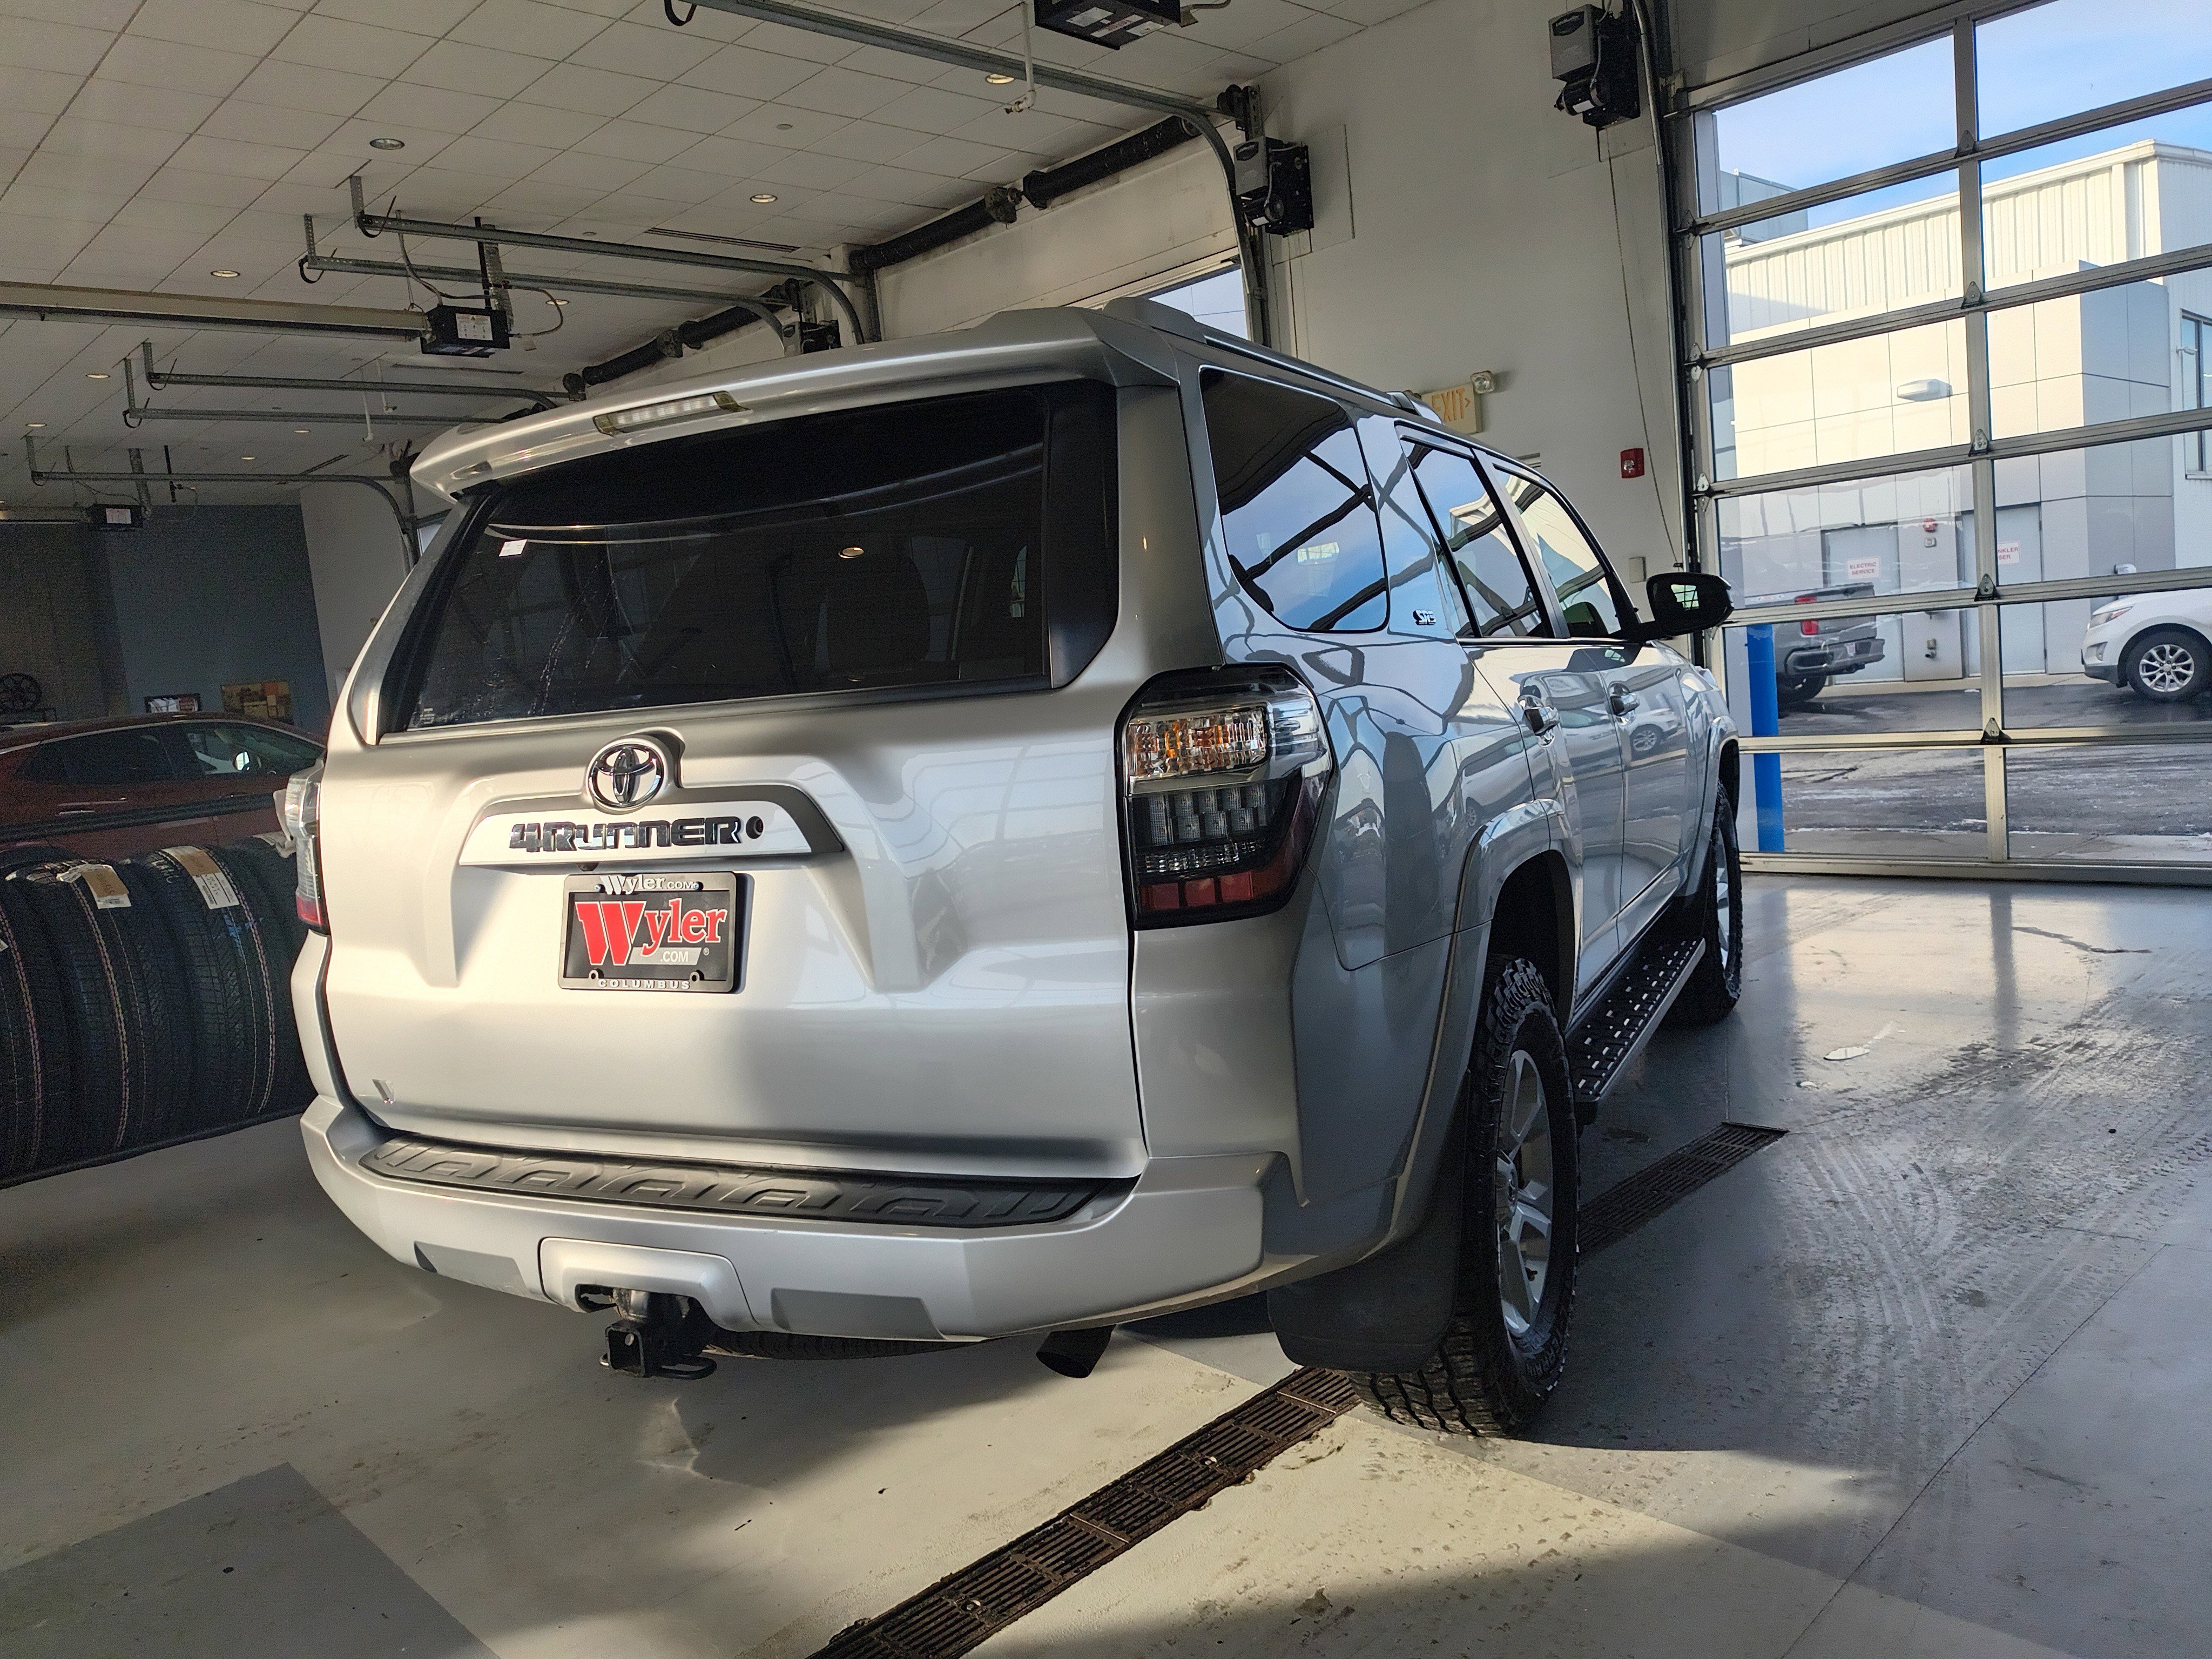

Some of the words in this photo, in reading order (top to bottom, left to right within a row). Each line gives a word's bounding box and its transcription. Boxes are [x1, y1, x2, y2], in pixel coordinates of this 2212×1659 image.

[1432, 388, 1466, 421] EXIT
[1413, 610, 1437, 625] SR5
[509, 816, 741, 852] 4RUNNER
[575, 898, 727, 966] Wyler
[598, 979, 691, 990] COLUMBUS
